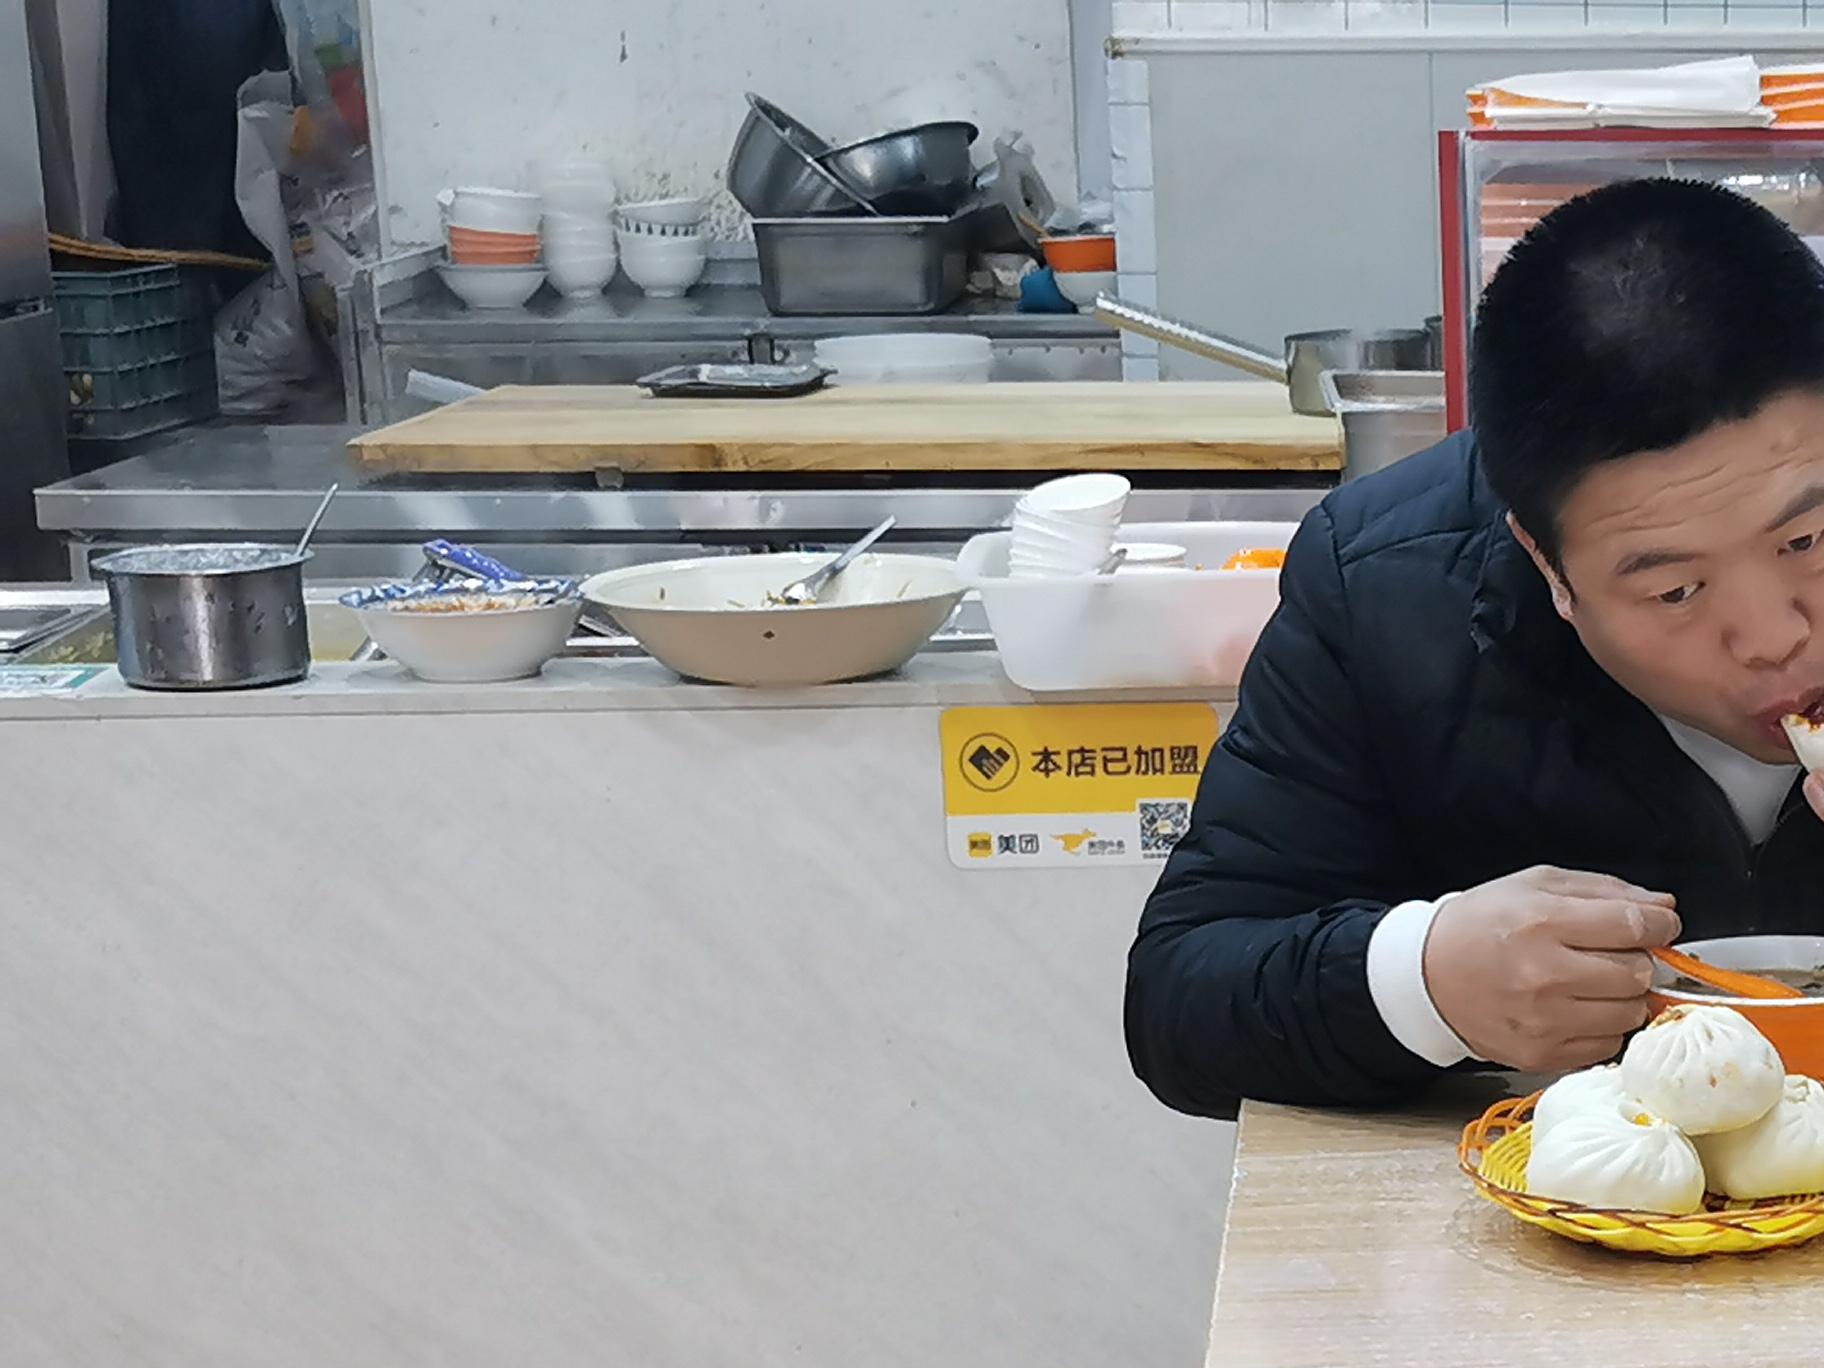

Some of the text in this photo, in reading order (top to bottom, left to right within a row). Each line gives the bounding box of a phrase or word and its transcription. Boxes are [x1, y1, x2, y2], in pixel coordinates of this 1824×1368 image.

[1031, 745, 1200, 778] 本店已加盟
[998, 834, 1040, 854] 美团
